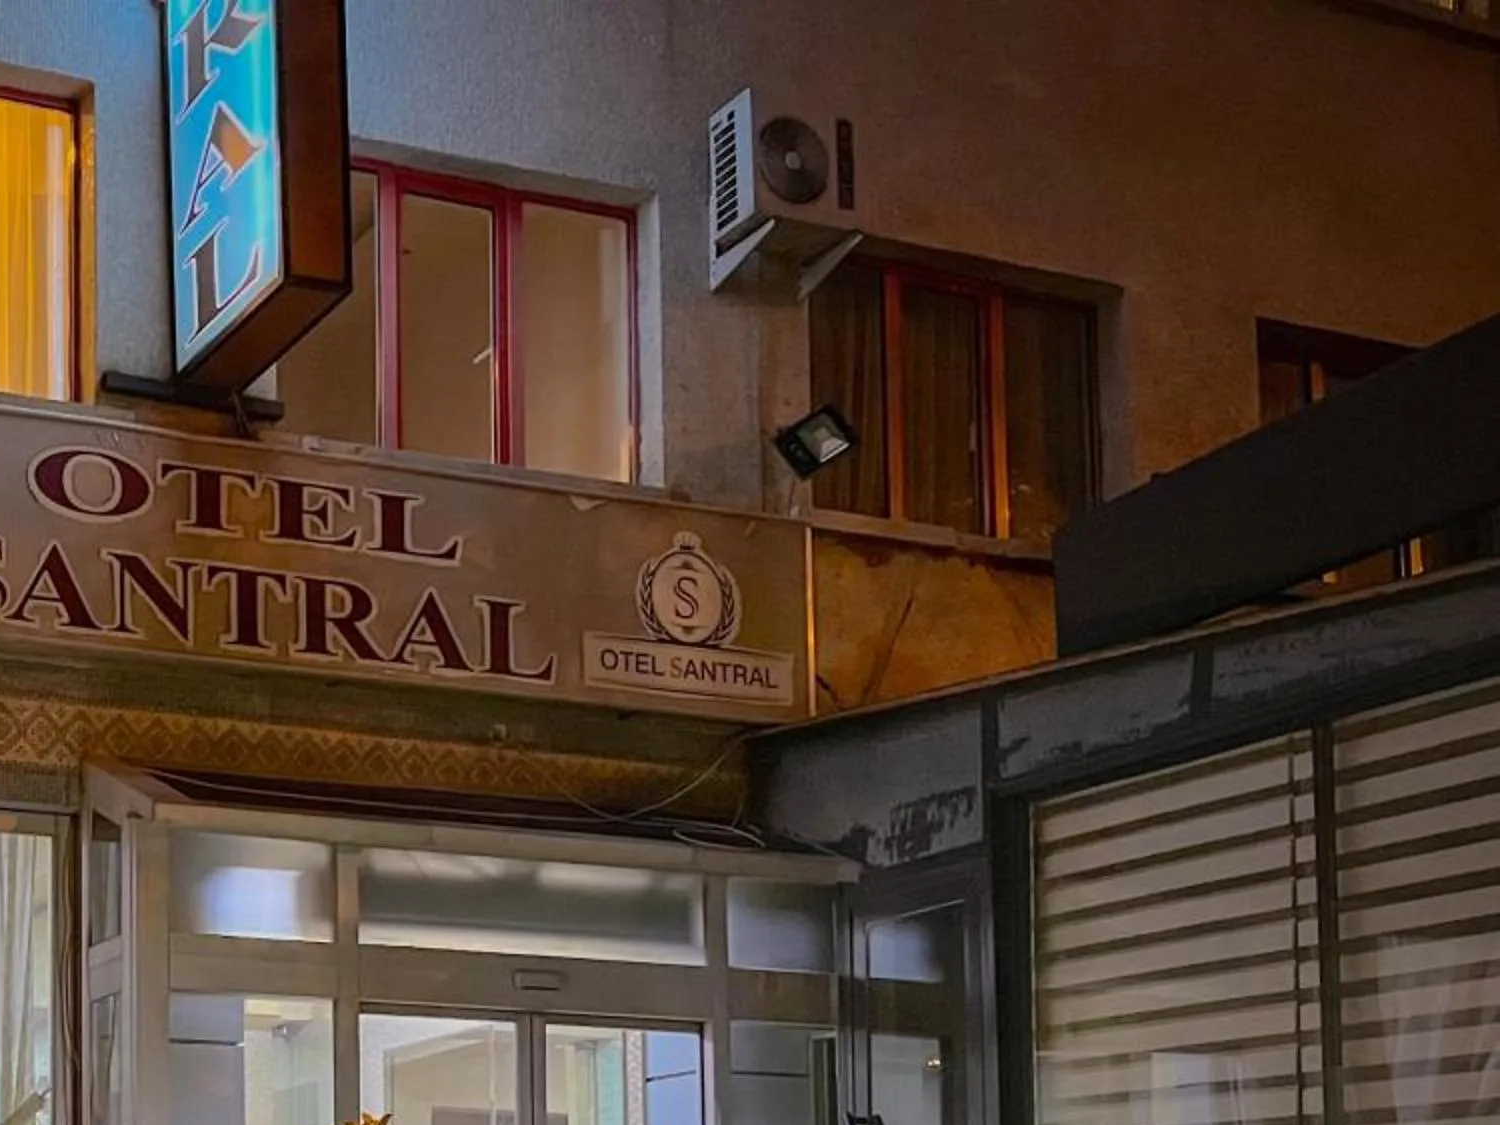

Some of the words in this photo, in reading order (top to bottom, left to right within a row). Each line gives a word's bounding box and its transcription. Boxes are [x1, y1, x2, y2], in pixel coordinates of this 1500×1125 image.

[29, 446, 463, 566] OTEL
[600, 649, 665, 677] OTEL
[670, 657, 779, 689] SANTRAL
